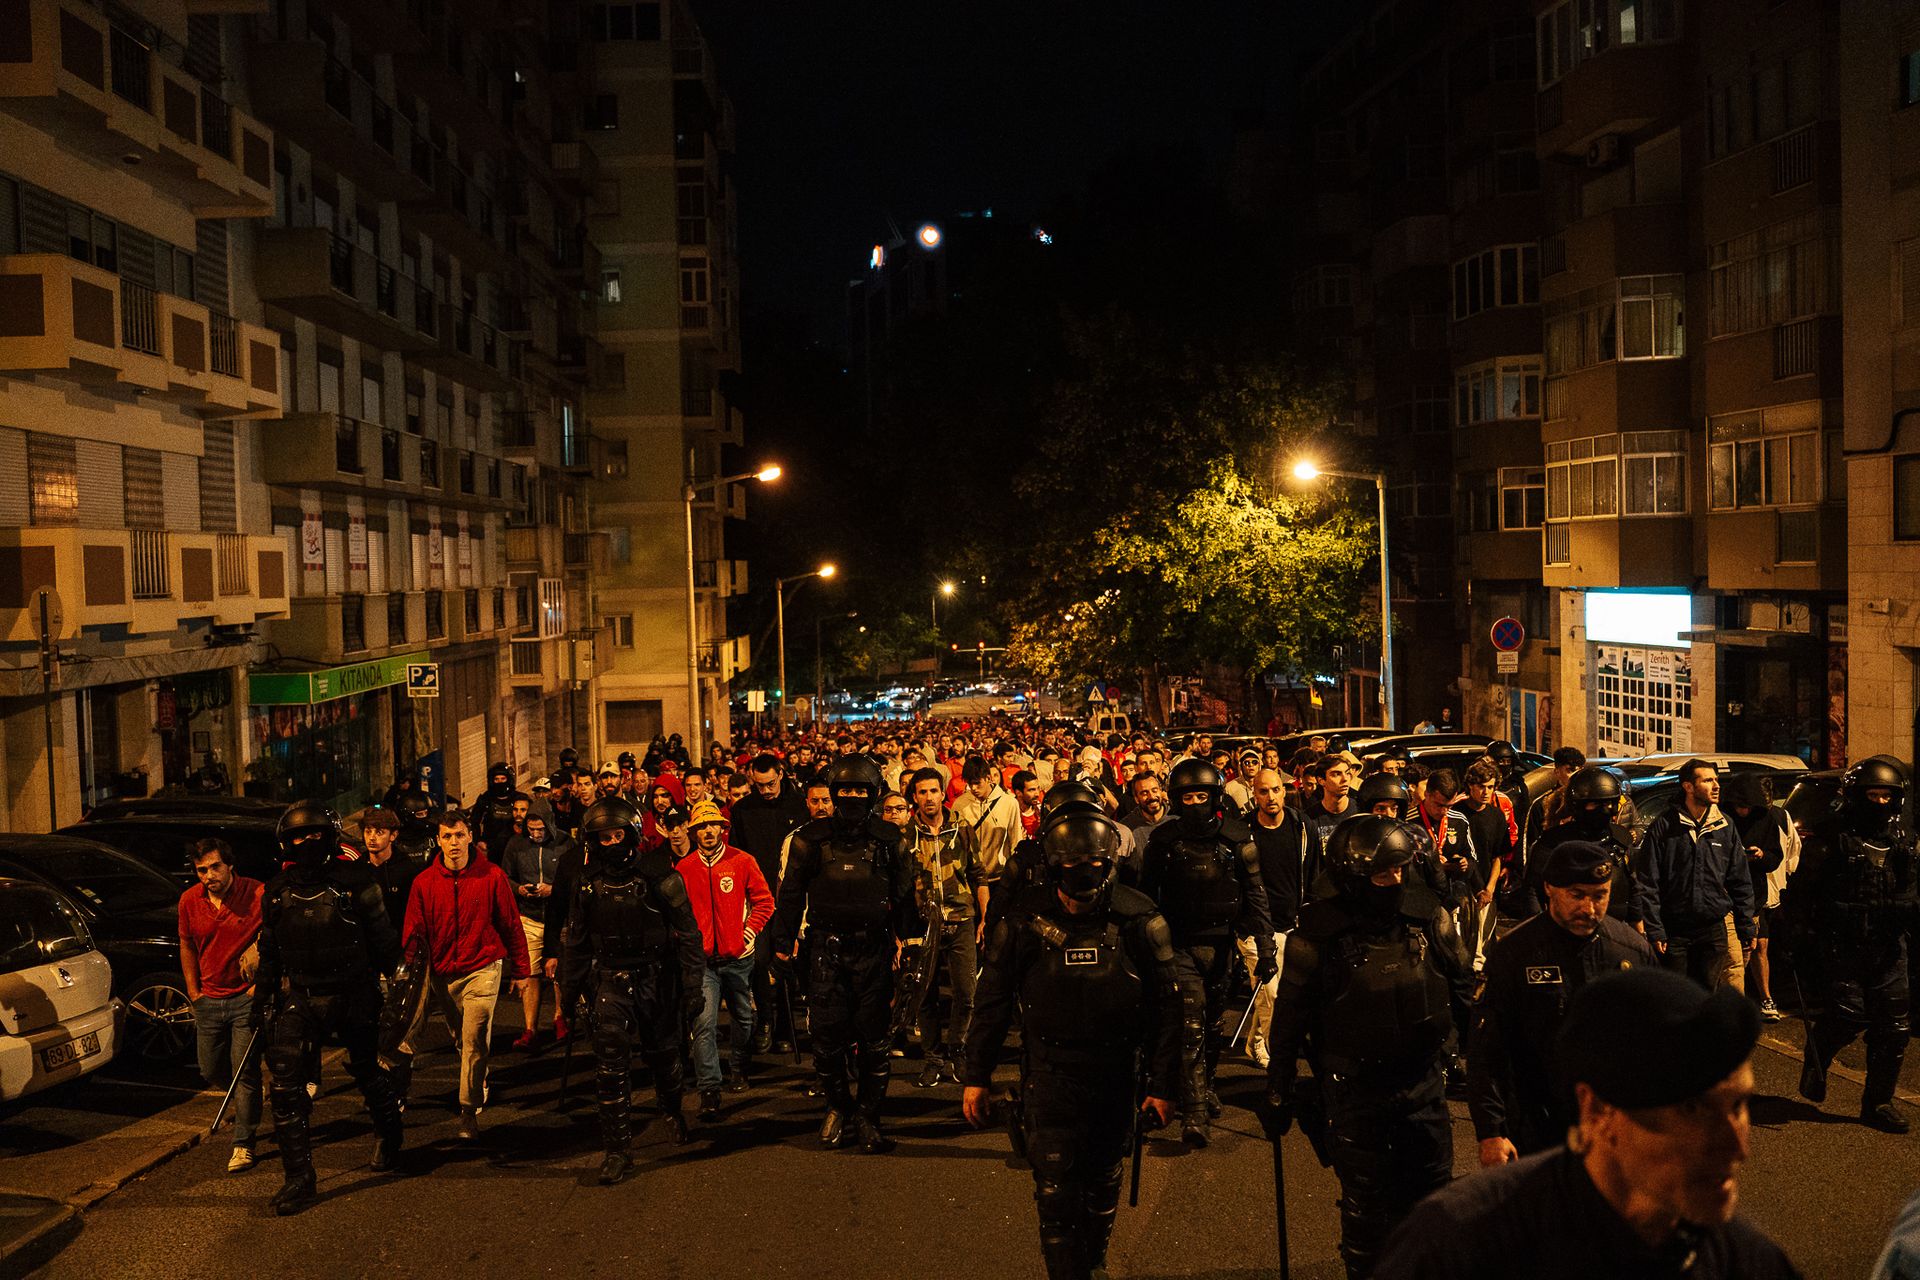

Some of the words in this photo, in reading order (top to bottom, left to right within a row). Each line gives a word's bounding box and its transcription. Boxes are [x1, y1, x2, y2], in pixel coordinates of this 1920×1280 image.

[1650, 653, 1670, 665] Zenith
[340, 664, 383, 693] KITANDA
[411, 667, 422, 684] P
